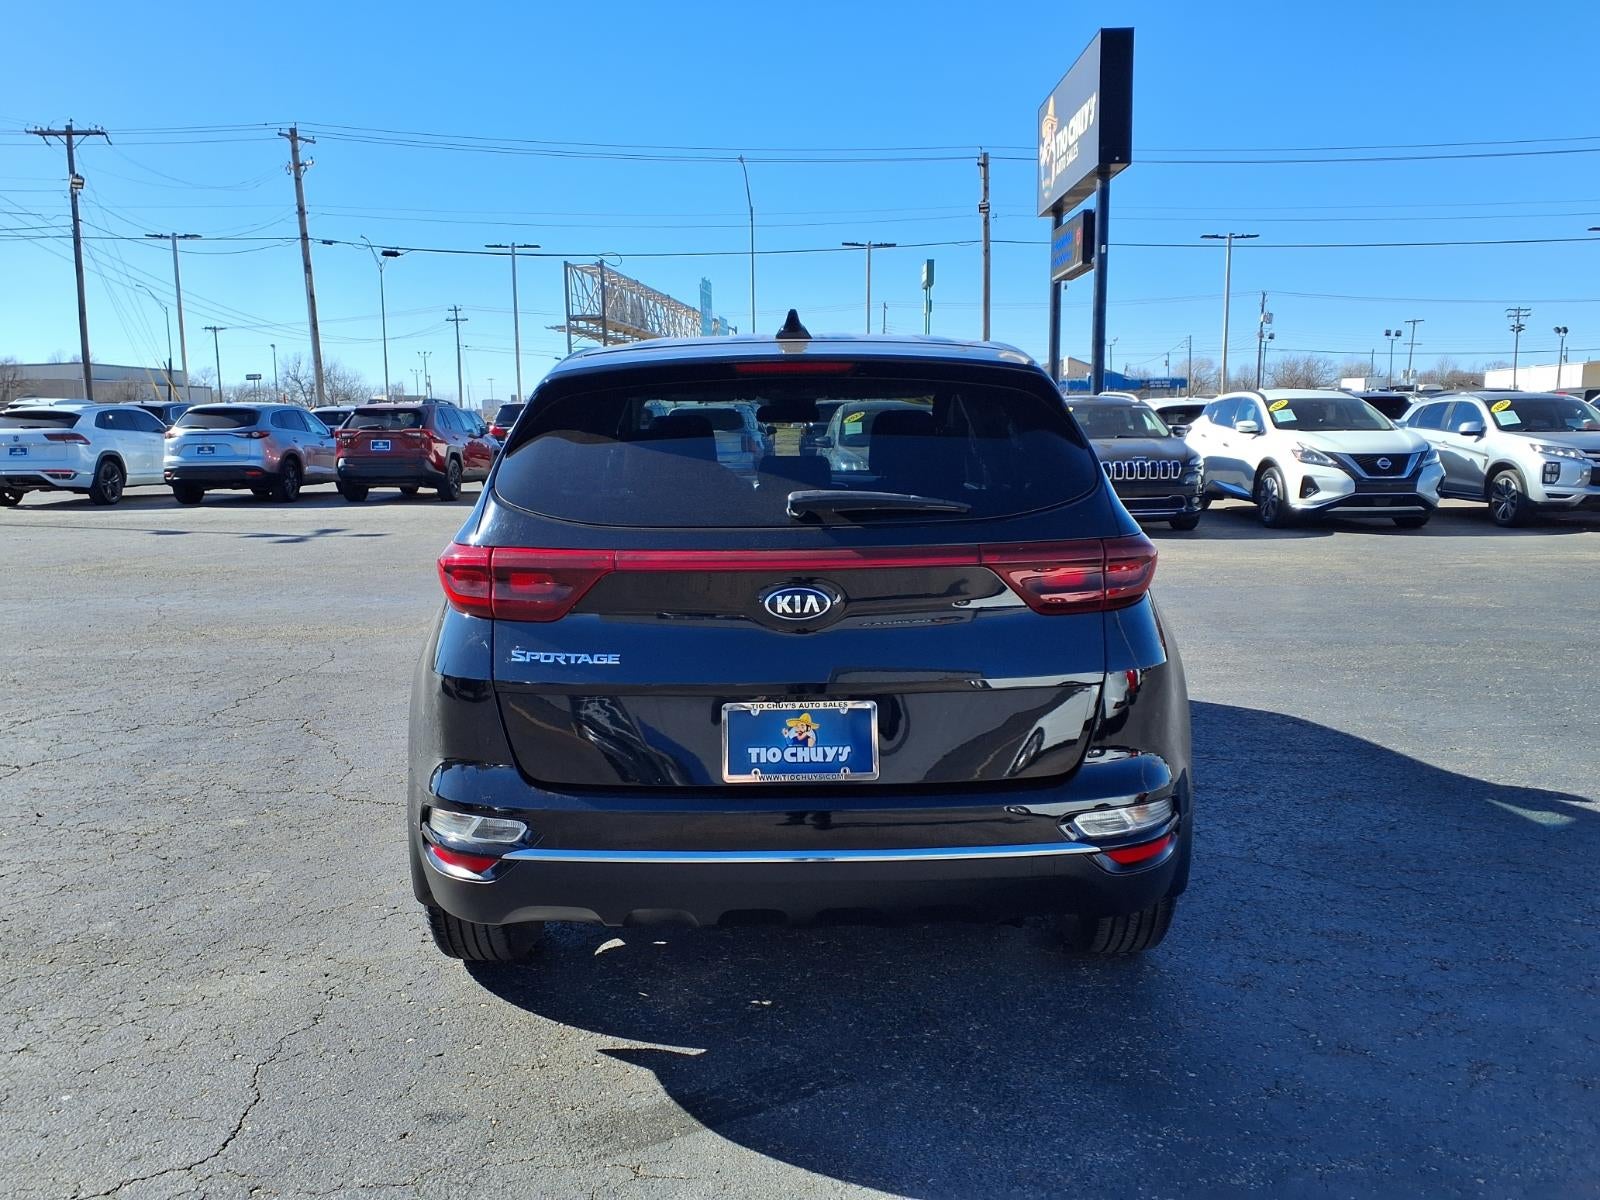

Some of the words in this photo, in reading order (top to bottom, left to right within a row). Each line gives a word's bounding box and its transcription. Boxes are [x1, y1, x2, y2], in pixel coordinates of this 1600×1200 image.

[775, 594, 820, 614] KIA
[510, 648, 621, 665] SPORTAGE
[822, 701, 848, 709] SALES
[748, 747, 782, 764] TIO
[784, 746, 852, 764] CHUY'S
[758, 773, 845, 782] WWW.TIOCHUYS.COM
